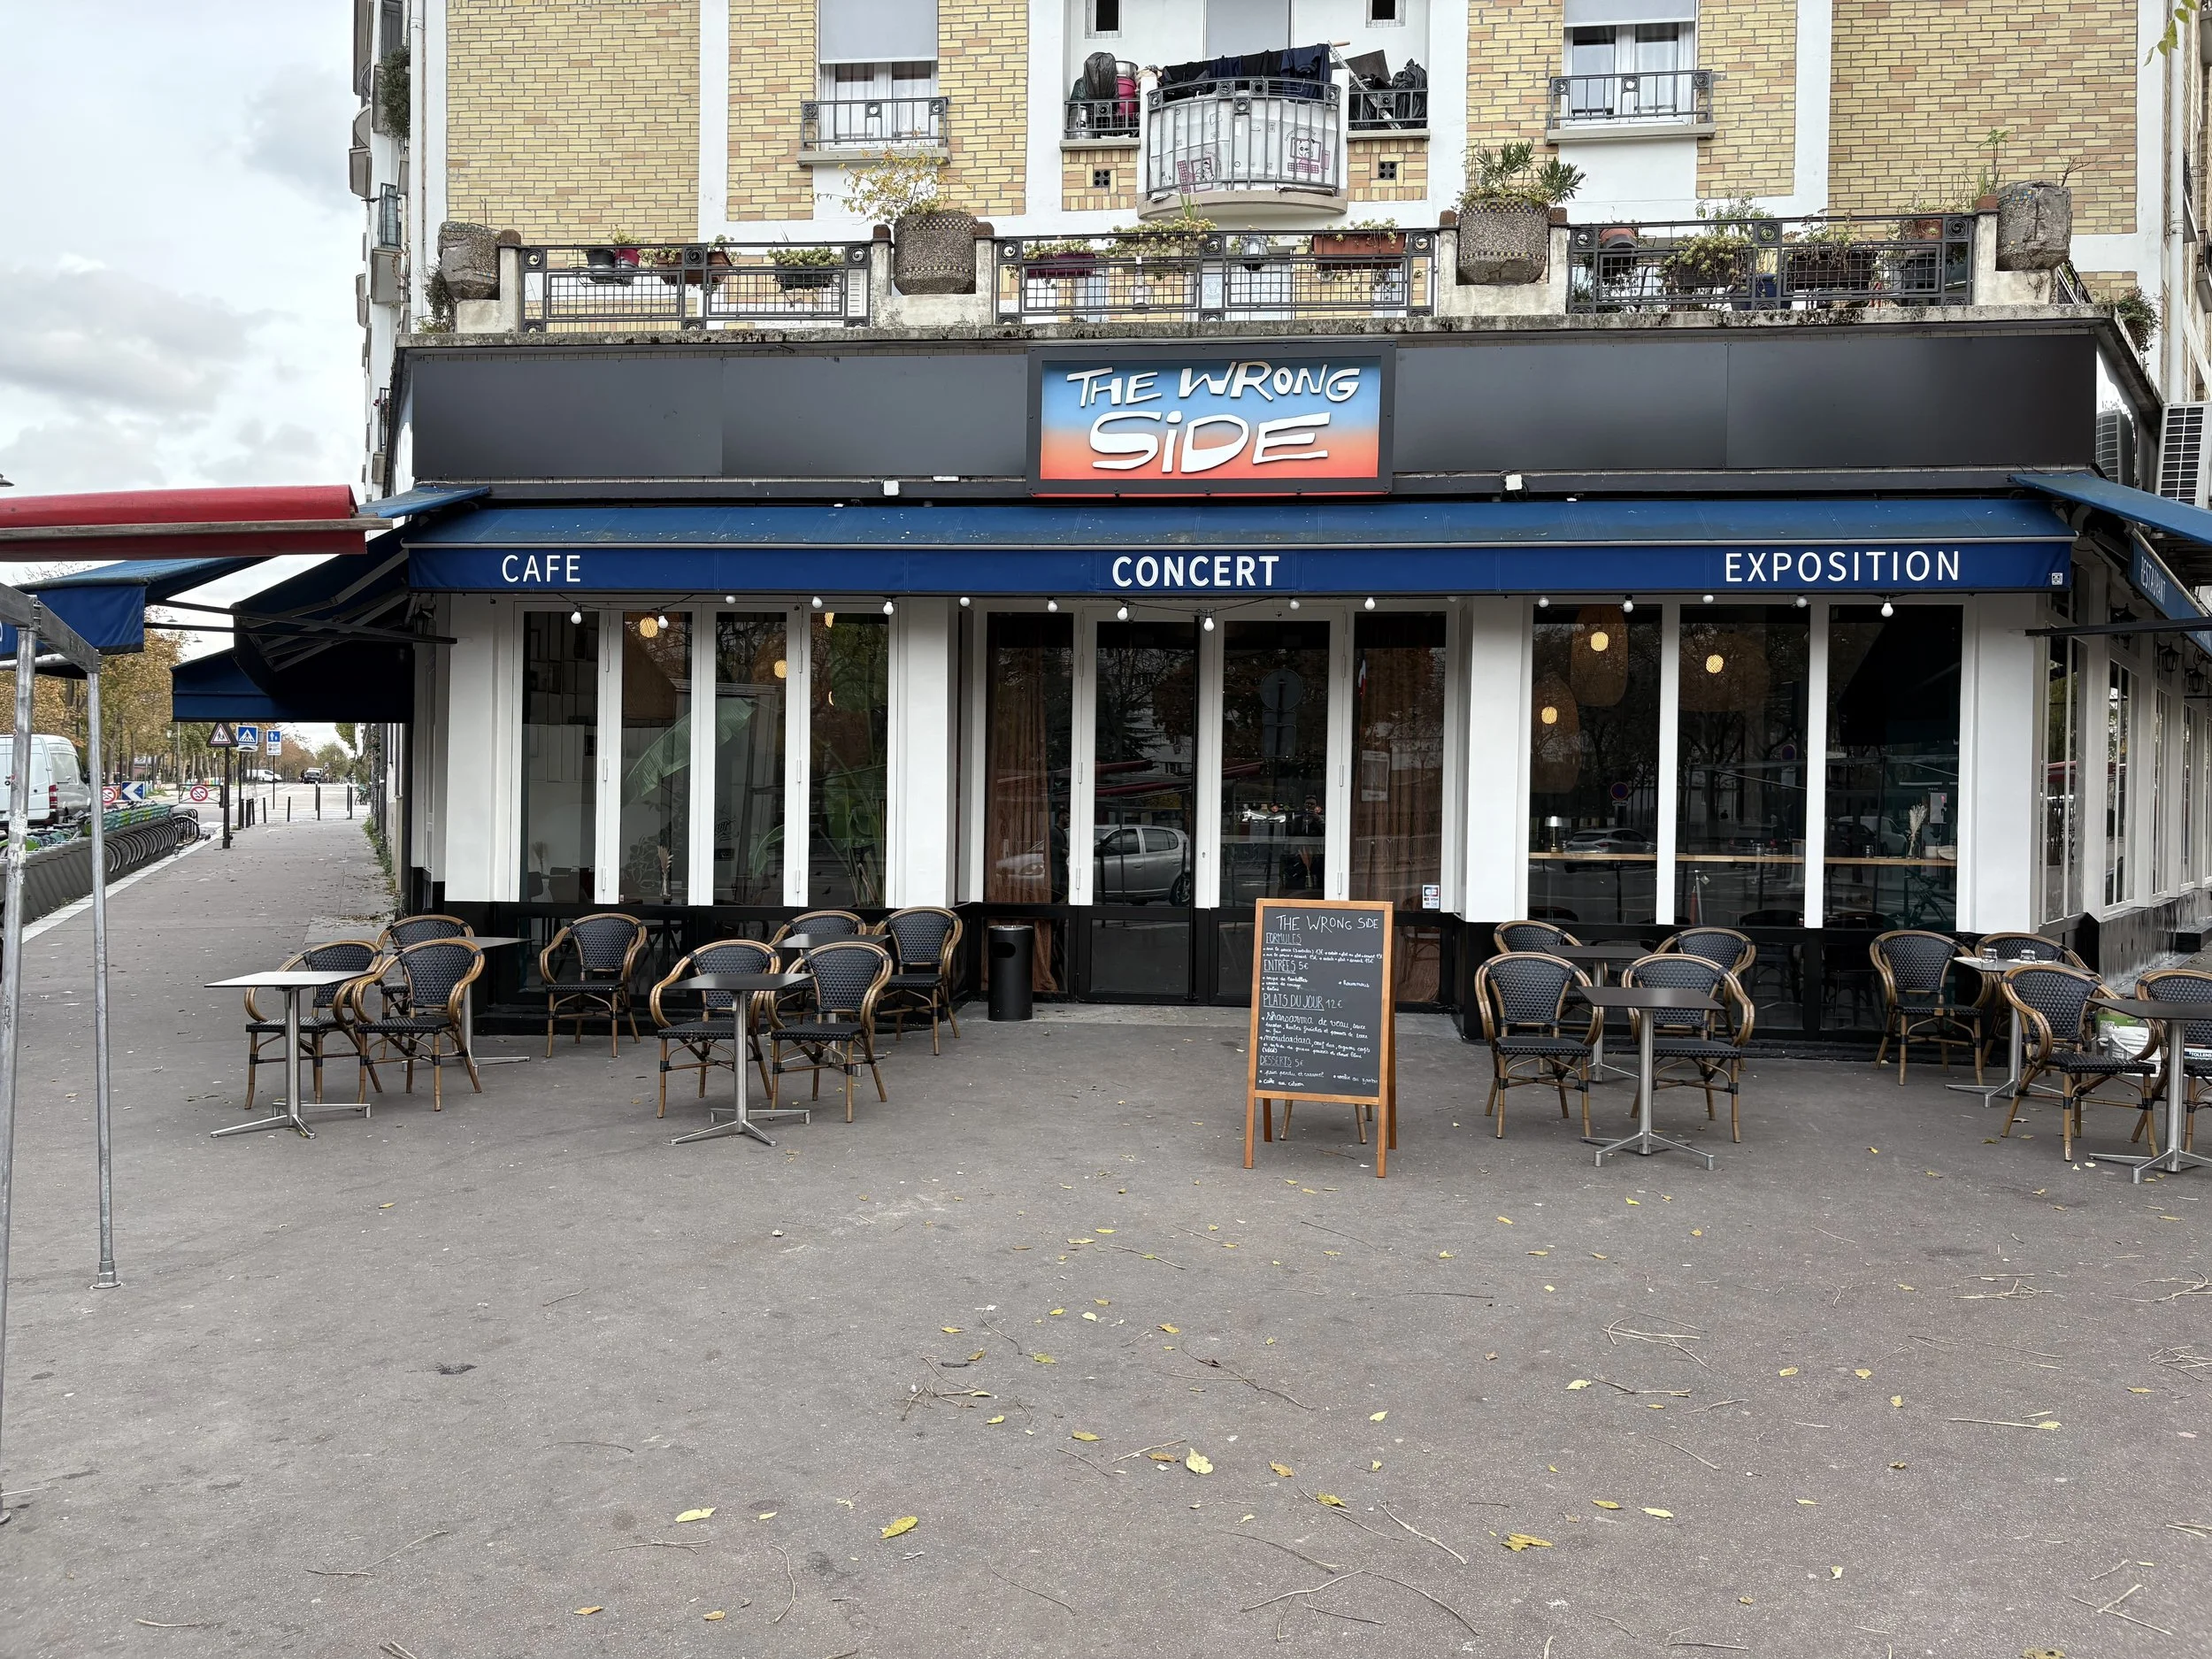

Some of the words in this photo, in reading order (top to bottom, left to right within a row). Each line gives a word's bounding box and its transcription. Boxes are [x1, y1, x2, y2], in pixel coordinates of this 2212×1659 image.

[1066, 366, 1162, 408] THE
[1179, 361, 1361, 402] WRONG
[502, 555, 581, 583] CAFE
[1112, 555, 1279, 588] CONCERT
[1725, 551, 1959, 582] EXPOSITION
[1276, 915, 1300, 930] THE
[1307, 916, 1352, 933] WRONG
[1265, 933, 1302, 944] FORMULES
[1263, 993, 1288, 1007] PLATS
[1290, 995, 1302, 1007] DU
[1303, 995, 1324, 1010] JOUR
[1326, 999, 1343, 1009] 12€
[1265, 1011, 1313, 1024] shawarma
[1259, 1056, 1292, 1068] DESSERTS
